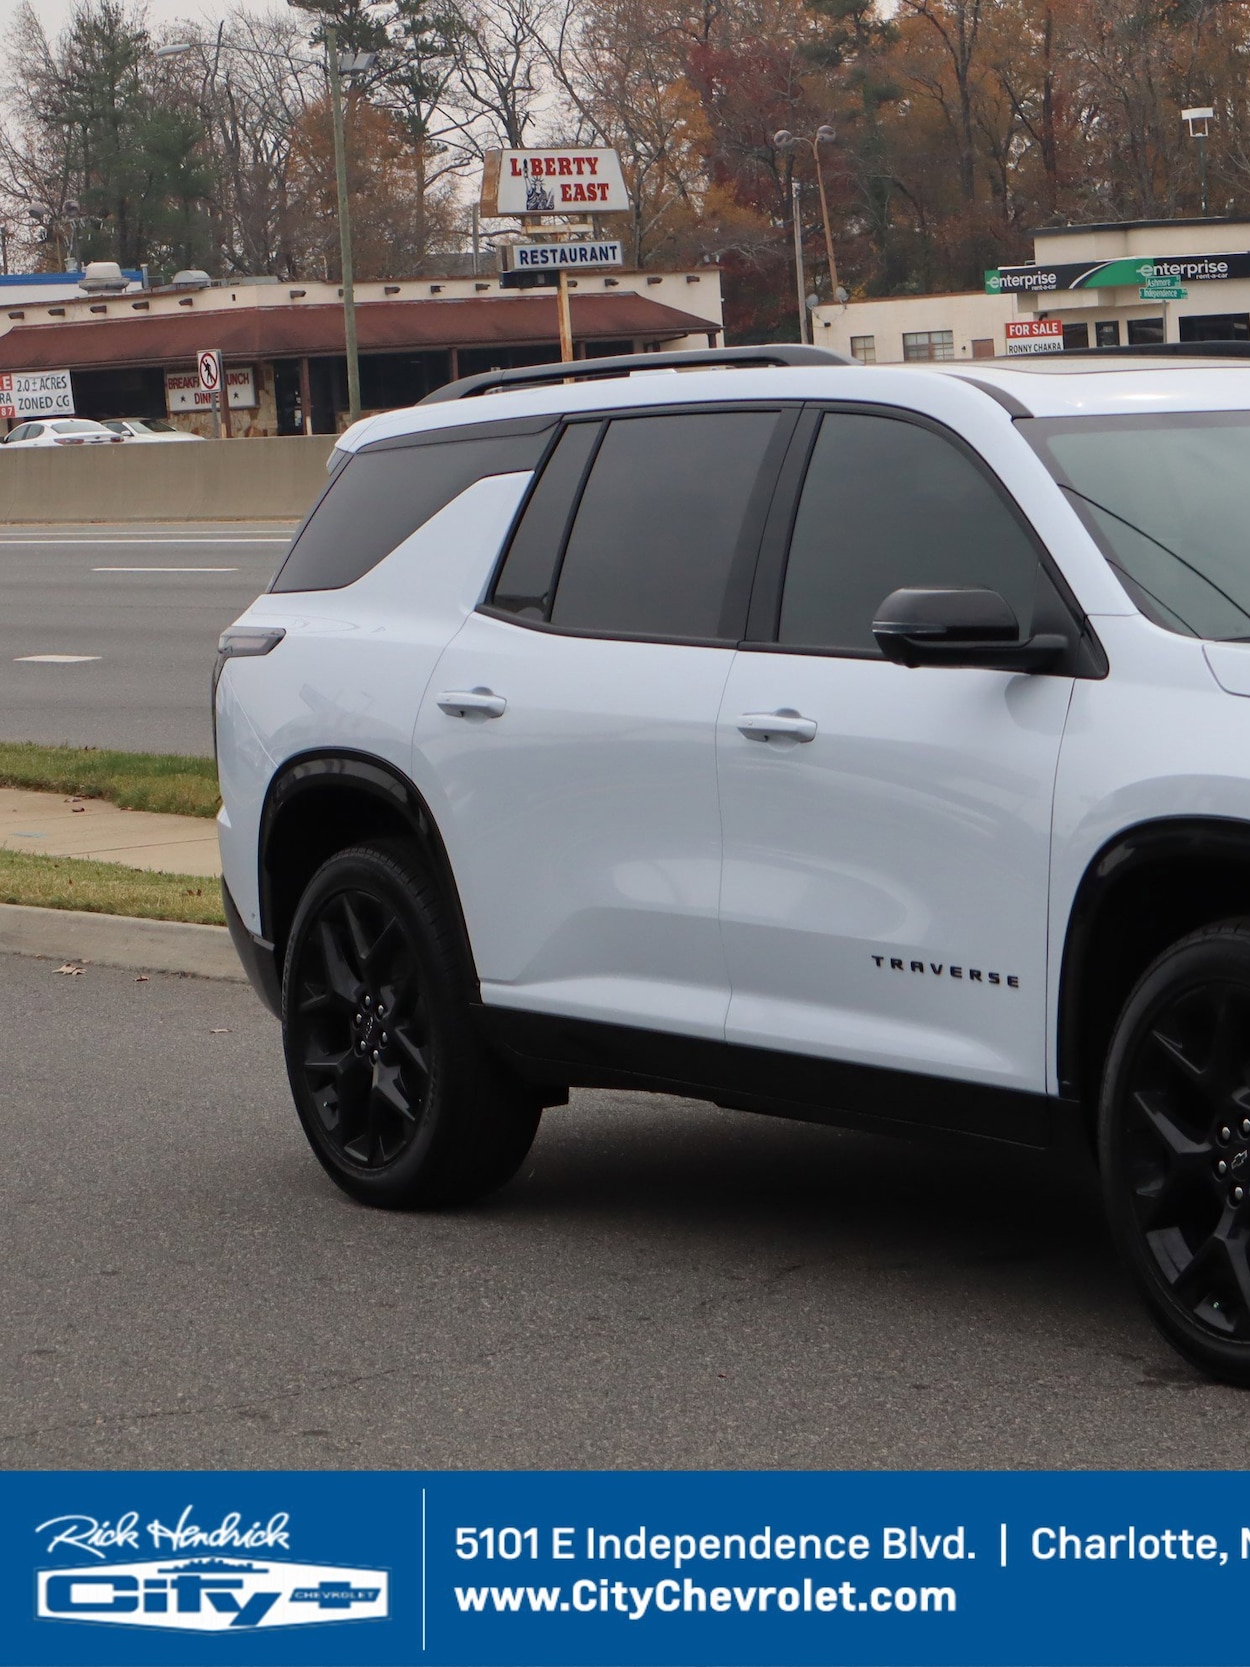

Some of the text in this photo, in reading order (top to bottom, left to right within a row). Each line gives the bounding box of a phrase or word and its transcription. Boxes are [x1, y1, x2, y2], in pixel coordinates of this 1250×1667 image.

[510, 157, 598, 176] LIBERTY
[560, 183, 609, 202] EAST
[519, 246, 617, 265] RESTAURANT
[1136, 260, 1228, 278] enterprise
[1196, 272, 1228, 280] rent-a-car
[986, 271, 1057, 289] enterprise
[1147, 278, 1171, 287] Ashmore
[1144, 289, 1178, 298] Independence
[1009, 322, 1059, 337] FOR SALE
[1008, 342, 1062, 354] RONNY CHAKRA
[17, 379, 30, 392] 2.0
[40, 376, 67, 391] ACRES
[168, 376, 200, 390] BREAKF
[18, 395, 70, 411] ZONED CG
[871, 955, 1019, 988] TRAVERSE
